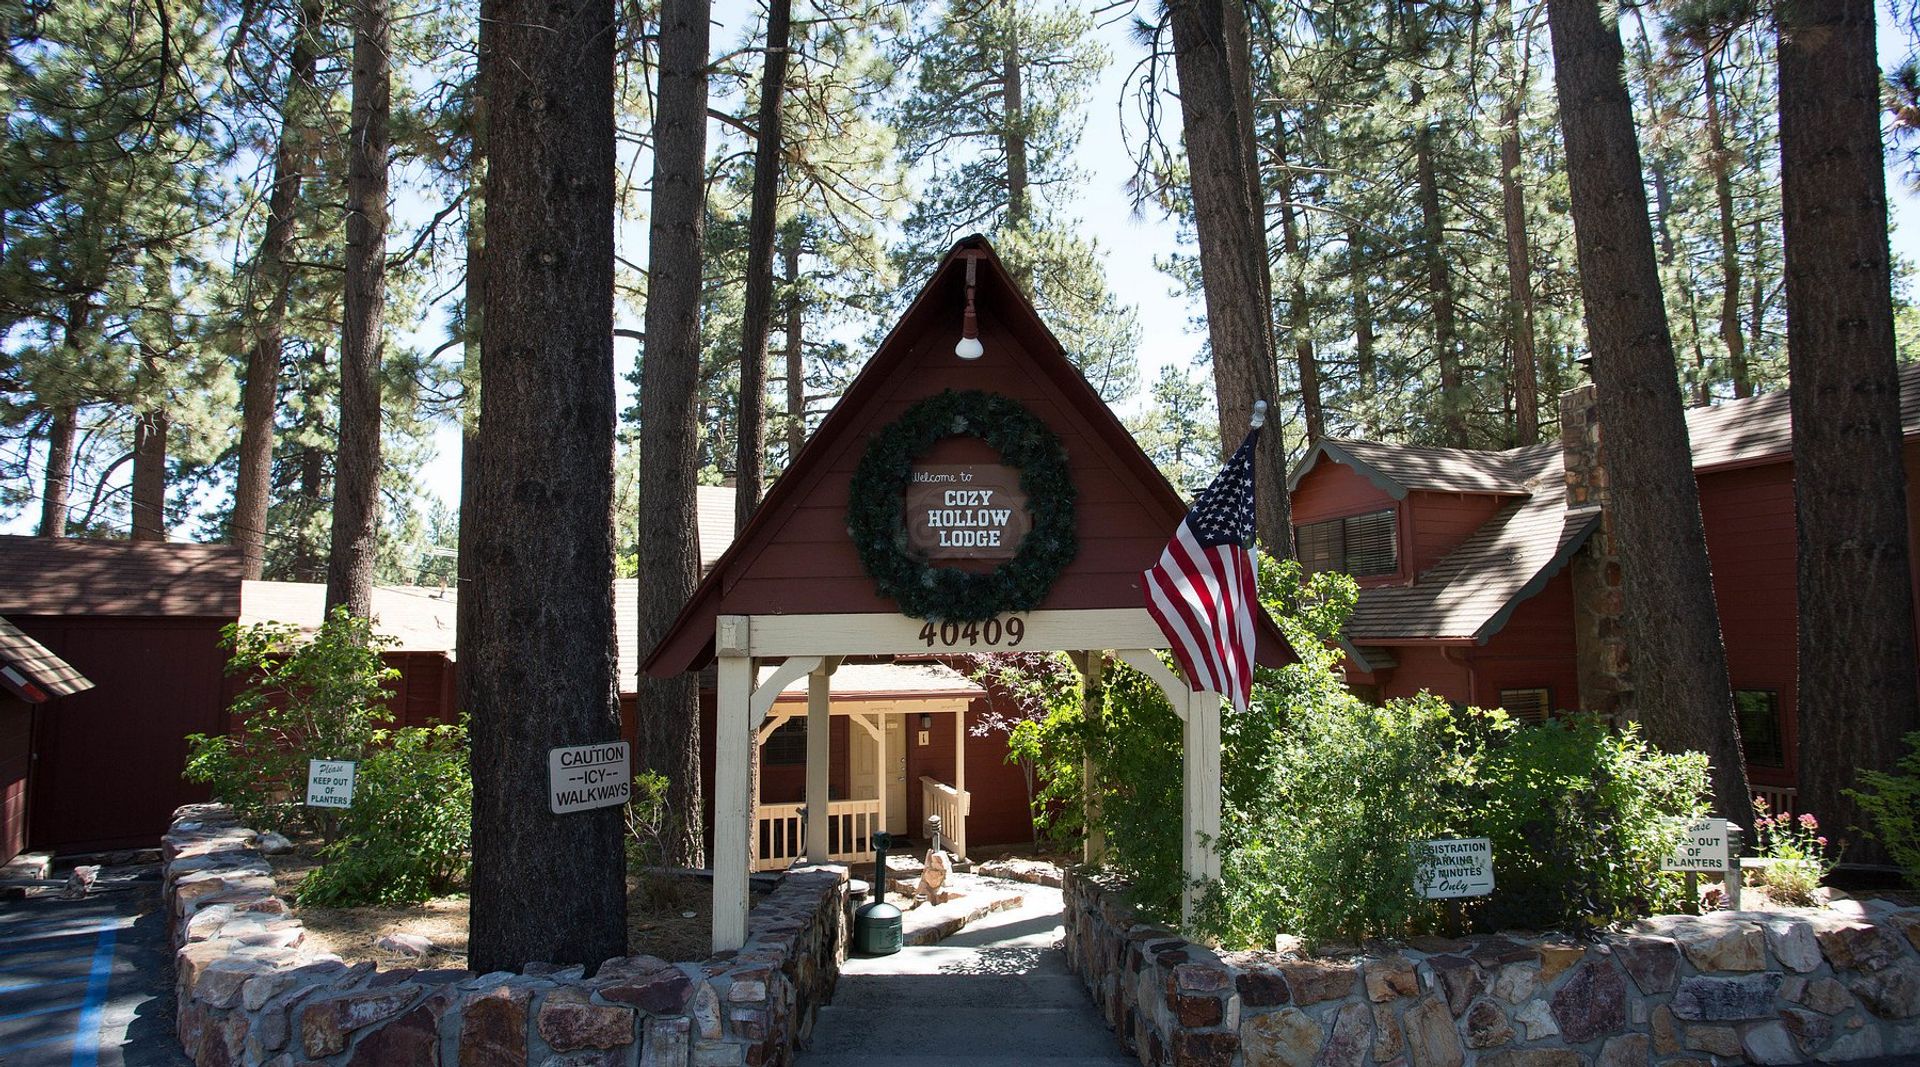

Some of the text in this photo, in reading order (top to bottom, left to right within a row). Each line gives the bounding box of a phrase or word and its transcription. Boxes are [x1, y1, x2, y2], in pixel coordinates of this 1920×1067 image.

[960, 471, 973, 482] to
[944, 490, 993, 506] COZY
[928, 509, 1011, 527] HOLLOW
[939, 530, 1001, 547] LODGE
[919, 617, 1025, 647] 40409
[560, 746, 624, 767] CAUTION
[319, 764, 343, 775] Please
[313, 777, 348, 786] KEEP OUT
[325, 786, 334, 795] OF
[556, 782, 628, 806] WALKWAYS
[311, 795, 348, 805] PLANTERS
[1698, 837, 1720, 847] OUT
[1687, 848, 1702, 857] OF
[1431, 855, 1473, 868] ARKING
[1667, 858, 1723, 868] PLANTERS
[1439, 867, 1482, 879] MINUTES
[1439, 880, 1469, 893] Only
